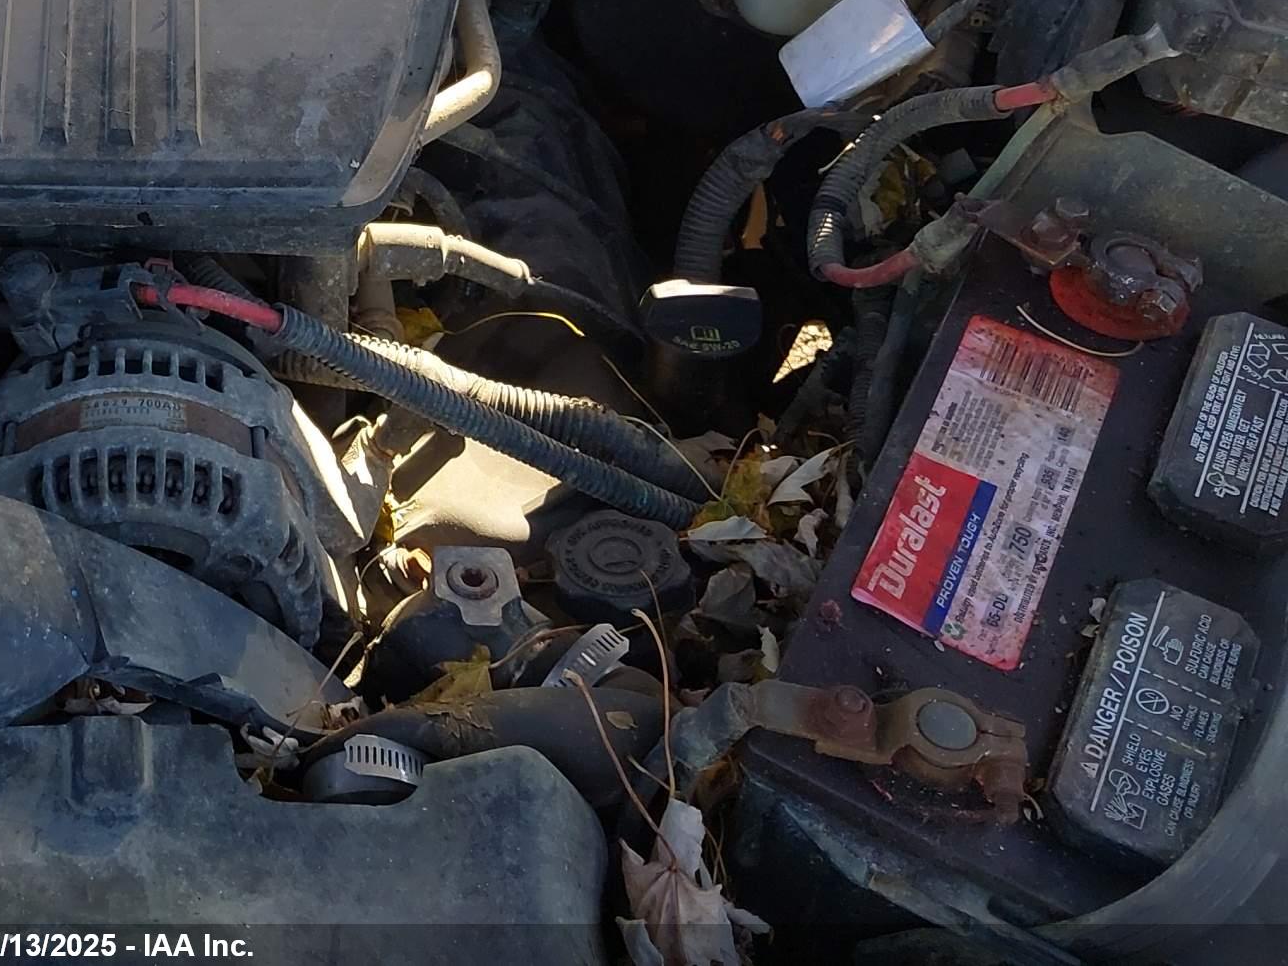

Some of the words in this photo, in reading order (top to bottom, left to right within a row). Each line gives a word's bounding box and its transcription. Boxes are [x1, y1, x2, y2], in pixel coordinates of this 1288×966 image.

[1201, 400, 1212, 411] THE
[1225, 389, 1245, 430] IMMEDIATELY
[1194, 420, 1204, 432] OUT
[1207, 415, 1216, 429] KEEP
[1250, 415, 1264, 433] FAST
[1190, 432, 1200, 447] KEEP
[1198, 440, 1208, 453] NOT
[1219, 430, 1233, 449] EYES
[1224, 457, 1238, 475] WITH
[1237, 417, 1250, 432] GET
[1245, 432, 1258, 451] HELP
[1195, 453, 1204, 462] DO
[1212, 448, 1227, 471] FLUSH
[1235, 452, 1254, 480] MEDICAL
[867, 474, 948, 600] Duralast
[1008, 526, 1031, 553] 750
[936, 555, 963, 607] PROVEN
[957, 512, 980, 552] TOUGH
[1184, 633, 1205, 673] SULFURIC
[1197, 614, 1211, 634] ACID
[1197, 663, 1209, 678] CAN
[1085, 688, 1121, 758] DANGER
[1113, 612, 1147, 673] POISON
[1169, 705, 1183, 720] NO
[1121, 733, 1140, 765] SHIELD
[1135, 747, 1152, 772] EYES
[1141, 748, 1166, 799] EXPLOSIVE
[1156, 773, 1175, 805] GASES
